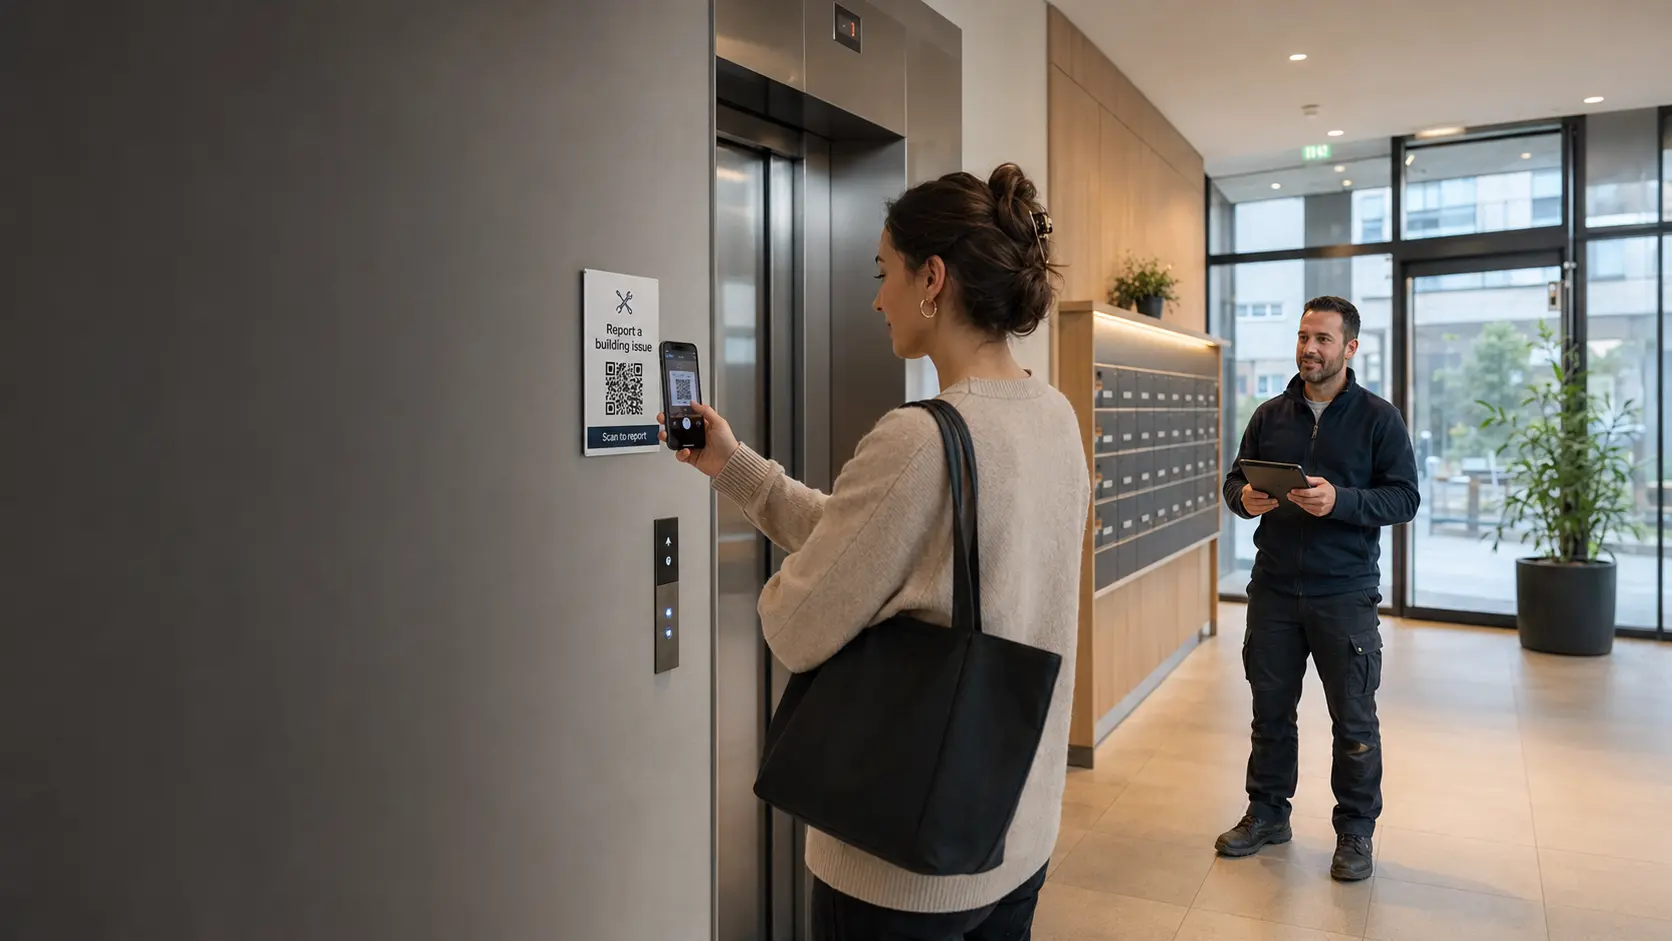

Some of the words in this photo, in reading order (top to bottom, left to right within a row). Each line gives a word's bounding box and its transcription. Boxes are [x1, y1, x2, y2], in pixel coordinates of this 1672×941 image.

[606, 323, 636, 337] Report
[637, 328, 642, 336] a
[595, 338, 630, 353] building
[632, 340, 652, 352] issue
[602, 432, 618, 442] Scan
[620, 433, 626, 441] to
[628, 432, 647, 442] report
